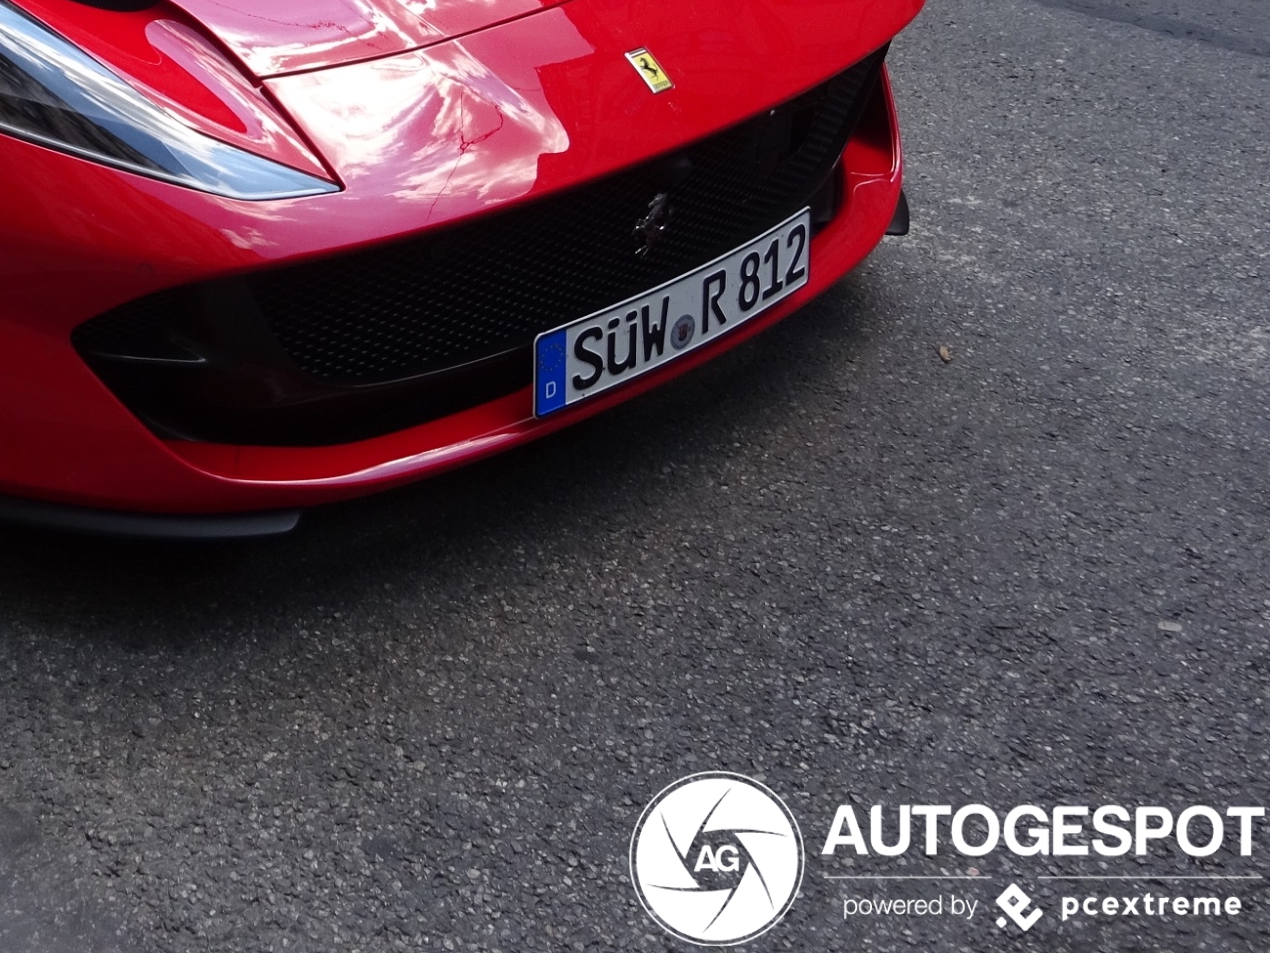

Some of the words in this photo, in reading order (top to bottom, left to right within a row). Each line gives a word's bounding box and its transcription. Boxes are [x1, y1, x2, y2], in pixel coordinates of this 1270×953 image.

[572, 296, 669, 391] SÜW
[701, 268, 728, 335] R
[738, 223, 806, 312] 812
[546, 381, 557, 398] D
